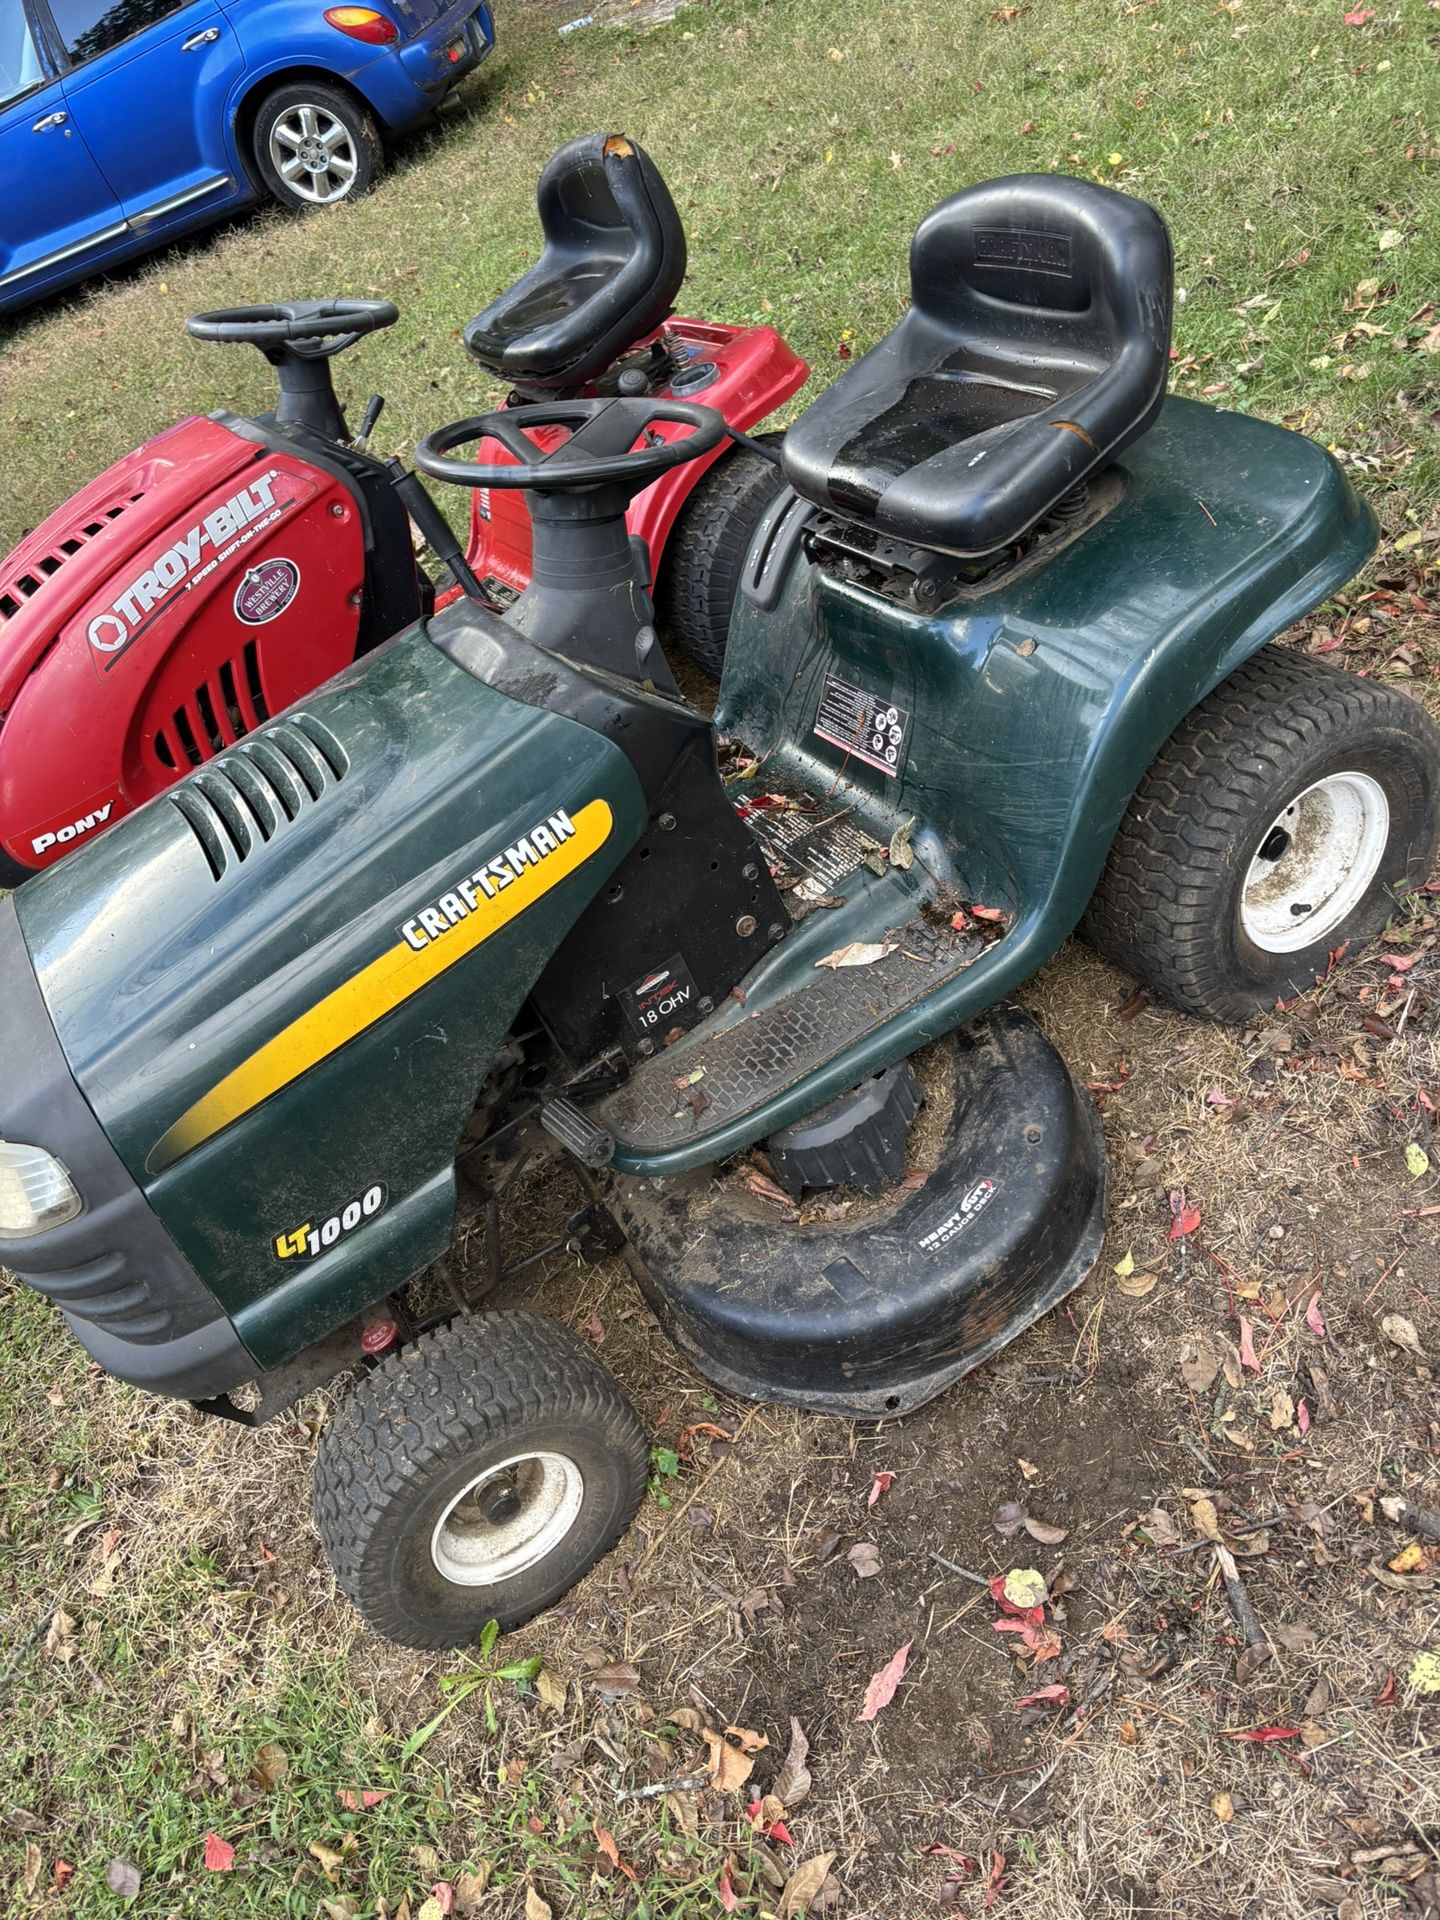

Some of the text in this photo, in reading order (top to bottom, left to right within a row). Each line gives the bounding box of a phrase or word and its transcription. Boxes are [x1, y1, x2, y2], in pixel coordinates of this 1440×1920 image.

[185, 509, 281, 590] 7 SPEED SHIFT-ON-THE-GO
[244, 569, 285, 608] WESTVILLE
[255, 578, 290, 615] BREWERY
[31, 802, 112, 855] PONY
[401, 809, 577, 951] CRAFTSMAN
[638, 981, 679, 1011] INTEK
[638, 986, 691, 1028] 18 OHV
[919, 1182, 988, 1248] HEAVY DUTY
[941, 1212, 975, 1242] GAUGE
[973, 1187, 997, 1211] DECK
